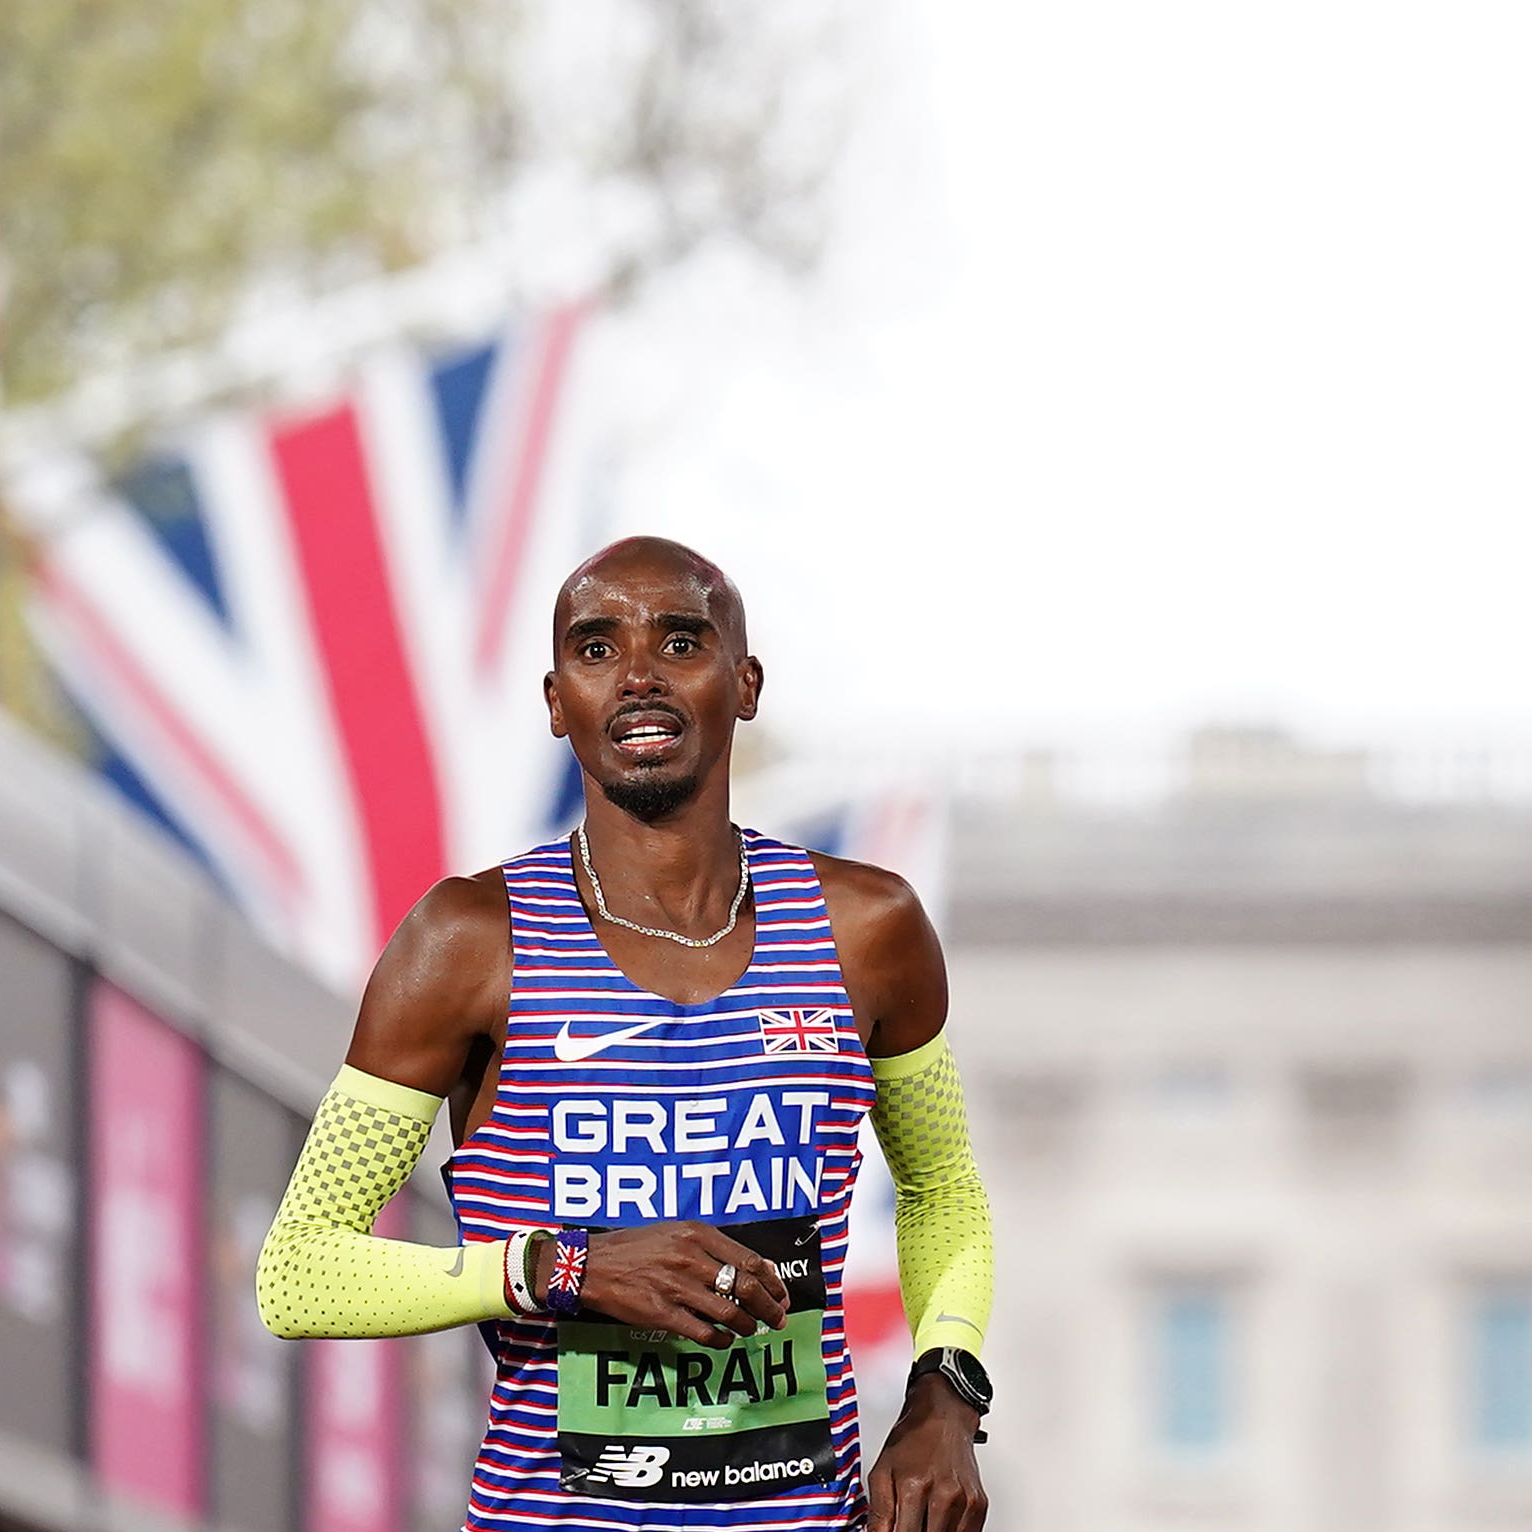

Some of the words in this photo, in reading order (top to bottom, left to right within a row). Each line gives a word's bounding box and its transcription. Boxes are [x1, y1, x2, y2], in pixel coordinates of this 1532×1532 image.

[552, 1092, 829, 1153] GREAT
[554, 1157, 824, 1218] BRITAIN
[596, 1340, 798, 1408] FARAH
[671, 1469, 722, 1488] new
[724, 1458, 815, 1486] balance
